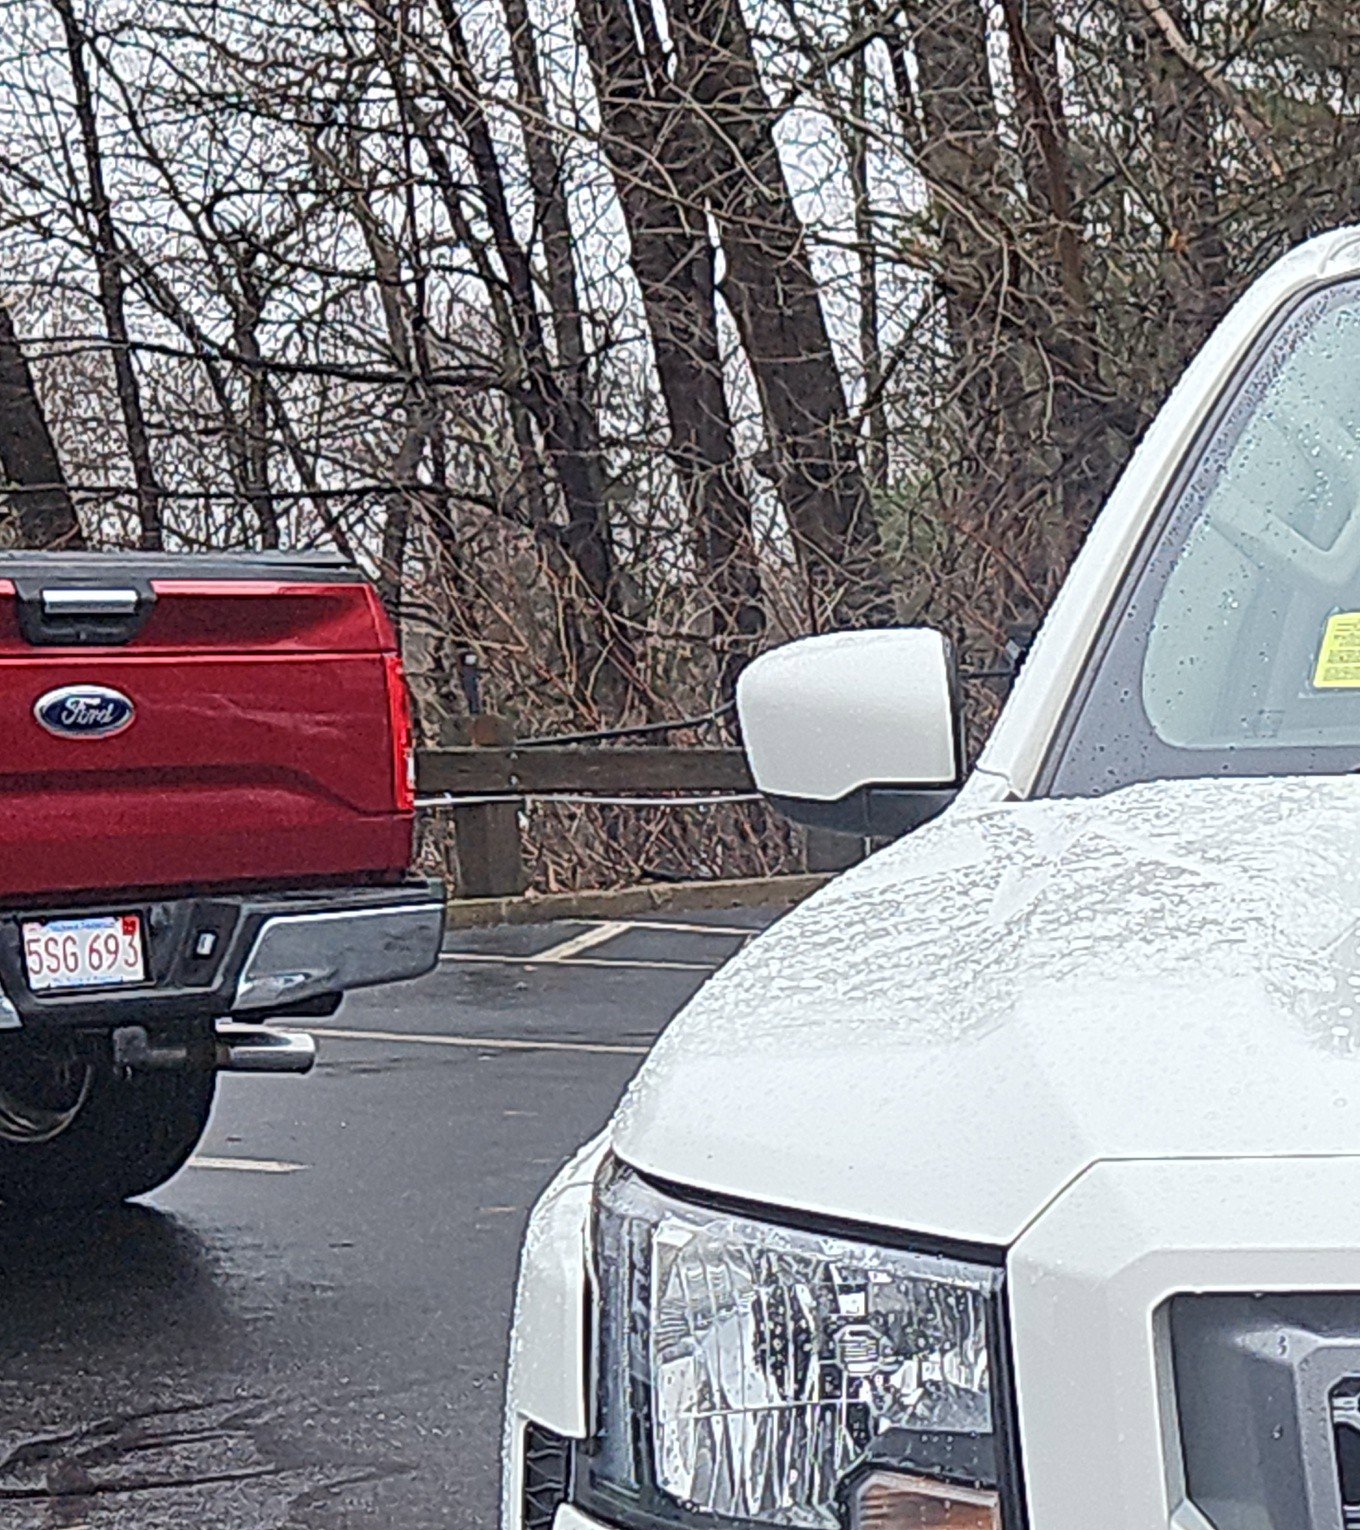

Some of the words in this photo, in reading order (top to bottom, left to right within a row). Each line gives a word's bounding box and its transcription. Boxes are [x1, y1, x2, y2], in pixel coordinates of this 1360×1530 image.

[61, 697, 115, 725] Ford
[26, 935, 79, 975] 5SG
[88, 931, 139, 971] 693
